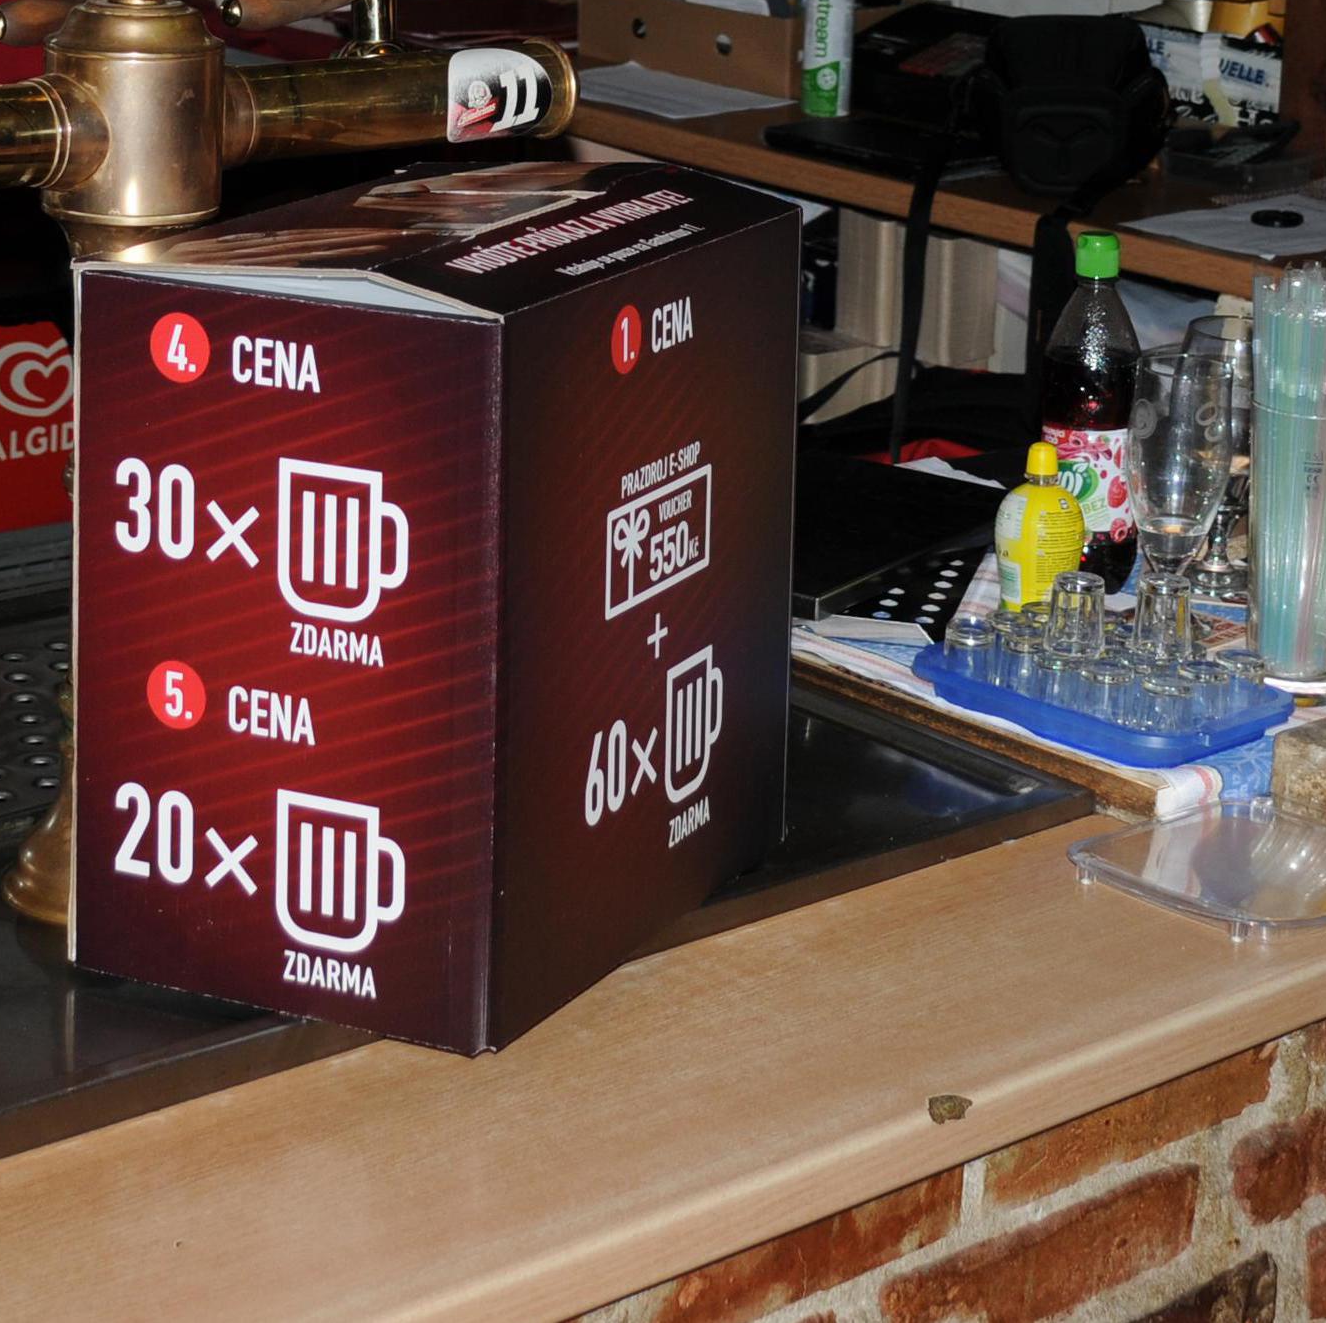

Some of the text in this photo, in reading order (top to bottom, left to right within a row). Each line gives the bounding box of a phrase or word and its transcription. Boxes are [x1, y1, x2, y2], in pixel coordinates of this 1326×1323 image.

[651, 295, 694, 355] CENA
[167, 323, 321, 394] 4. CENA
[621, 440, 701, 499] PRAZDROJ E-SHOP
[658, 489, 693, 523] VOUCHER
[289, 621, 384, 668] ZDARMA
[164, 669, 316, 746] 5. CENA
[667, 795, 710, 849] ZDARMA
[282, 949, 377, 999] ZDARMA
